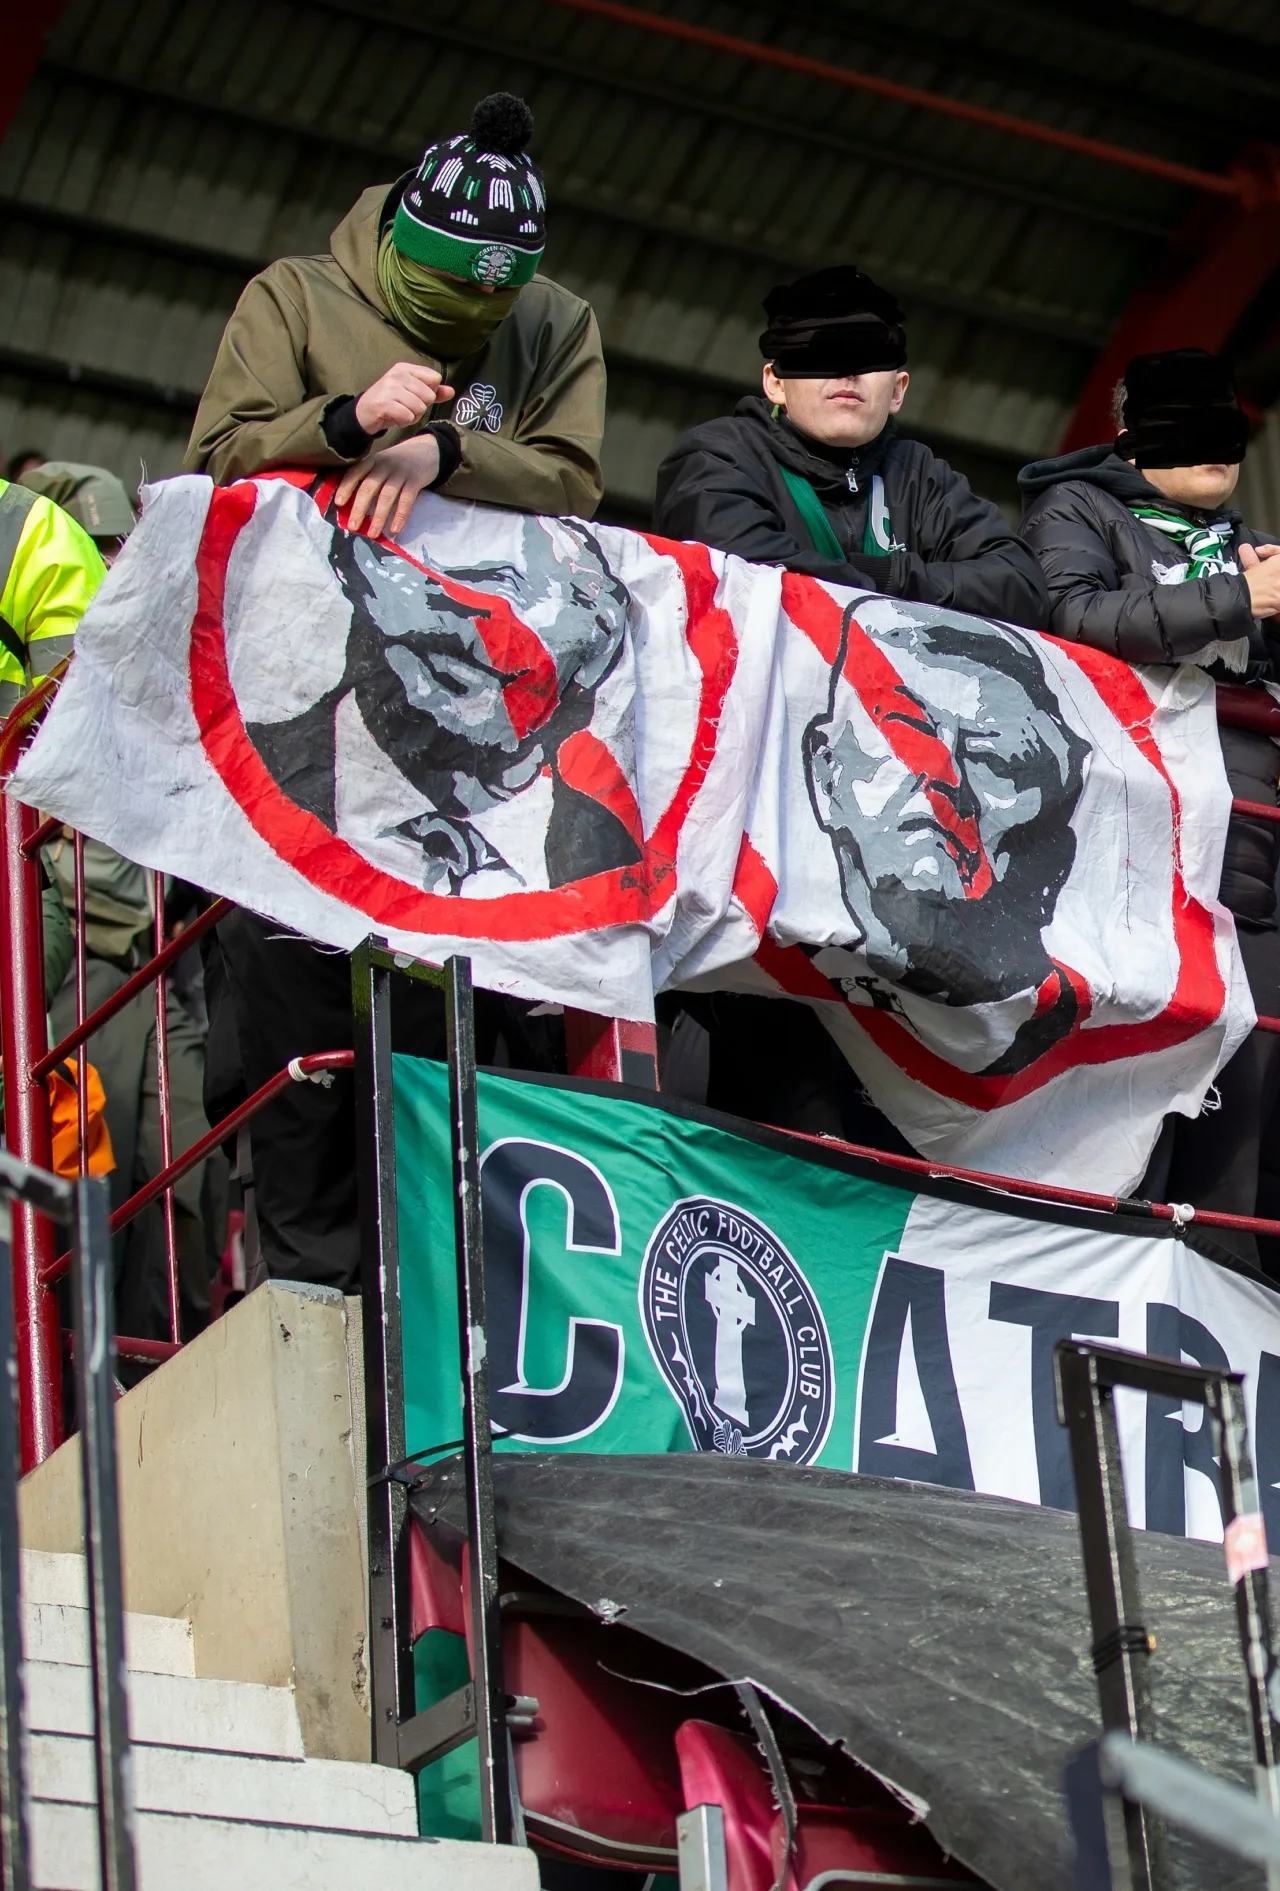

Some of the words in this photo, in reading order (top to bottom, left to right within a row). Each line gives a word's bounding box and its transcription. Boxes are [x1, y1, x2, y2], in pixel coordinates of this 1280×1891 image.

[479, 245, 498, 257] GREEN
[666, 1210, 710, 1265] CELTIC
[716, 1212, 804, 1315] FOOTBALL
[655, 1267, 678, 1321] THE
[796, 1326, 821, 1400] CLUB
